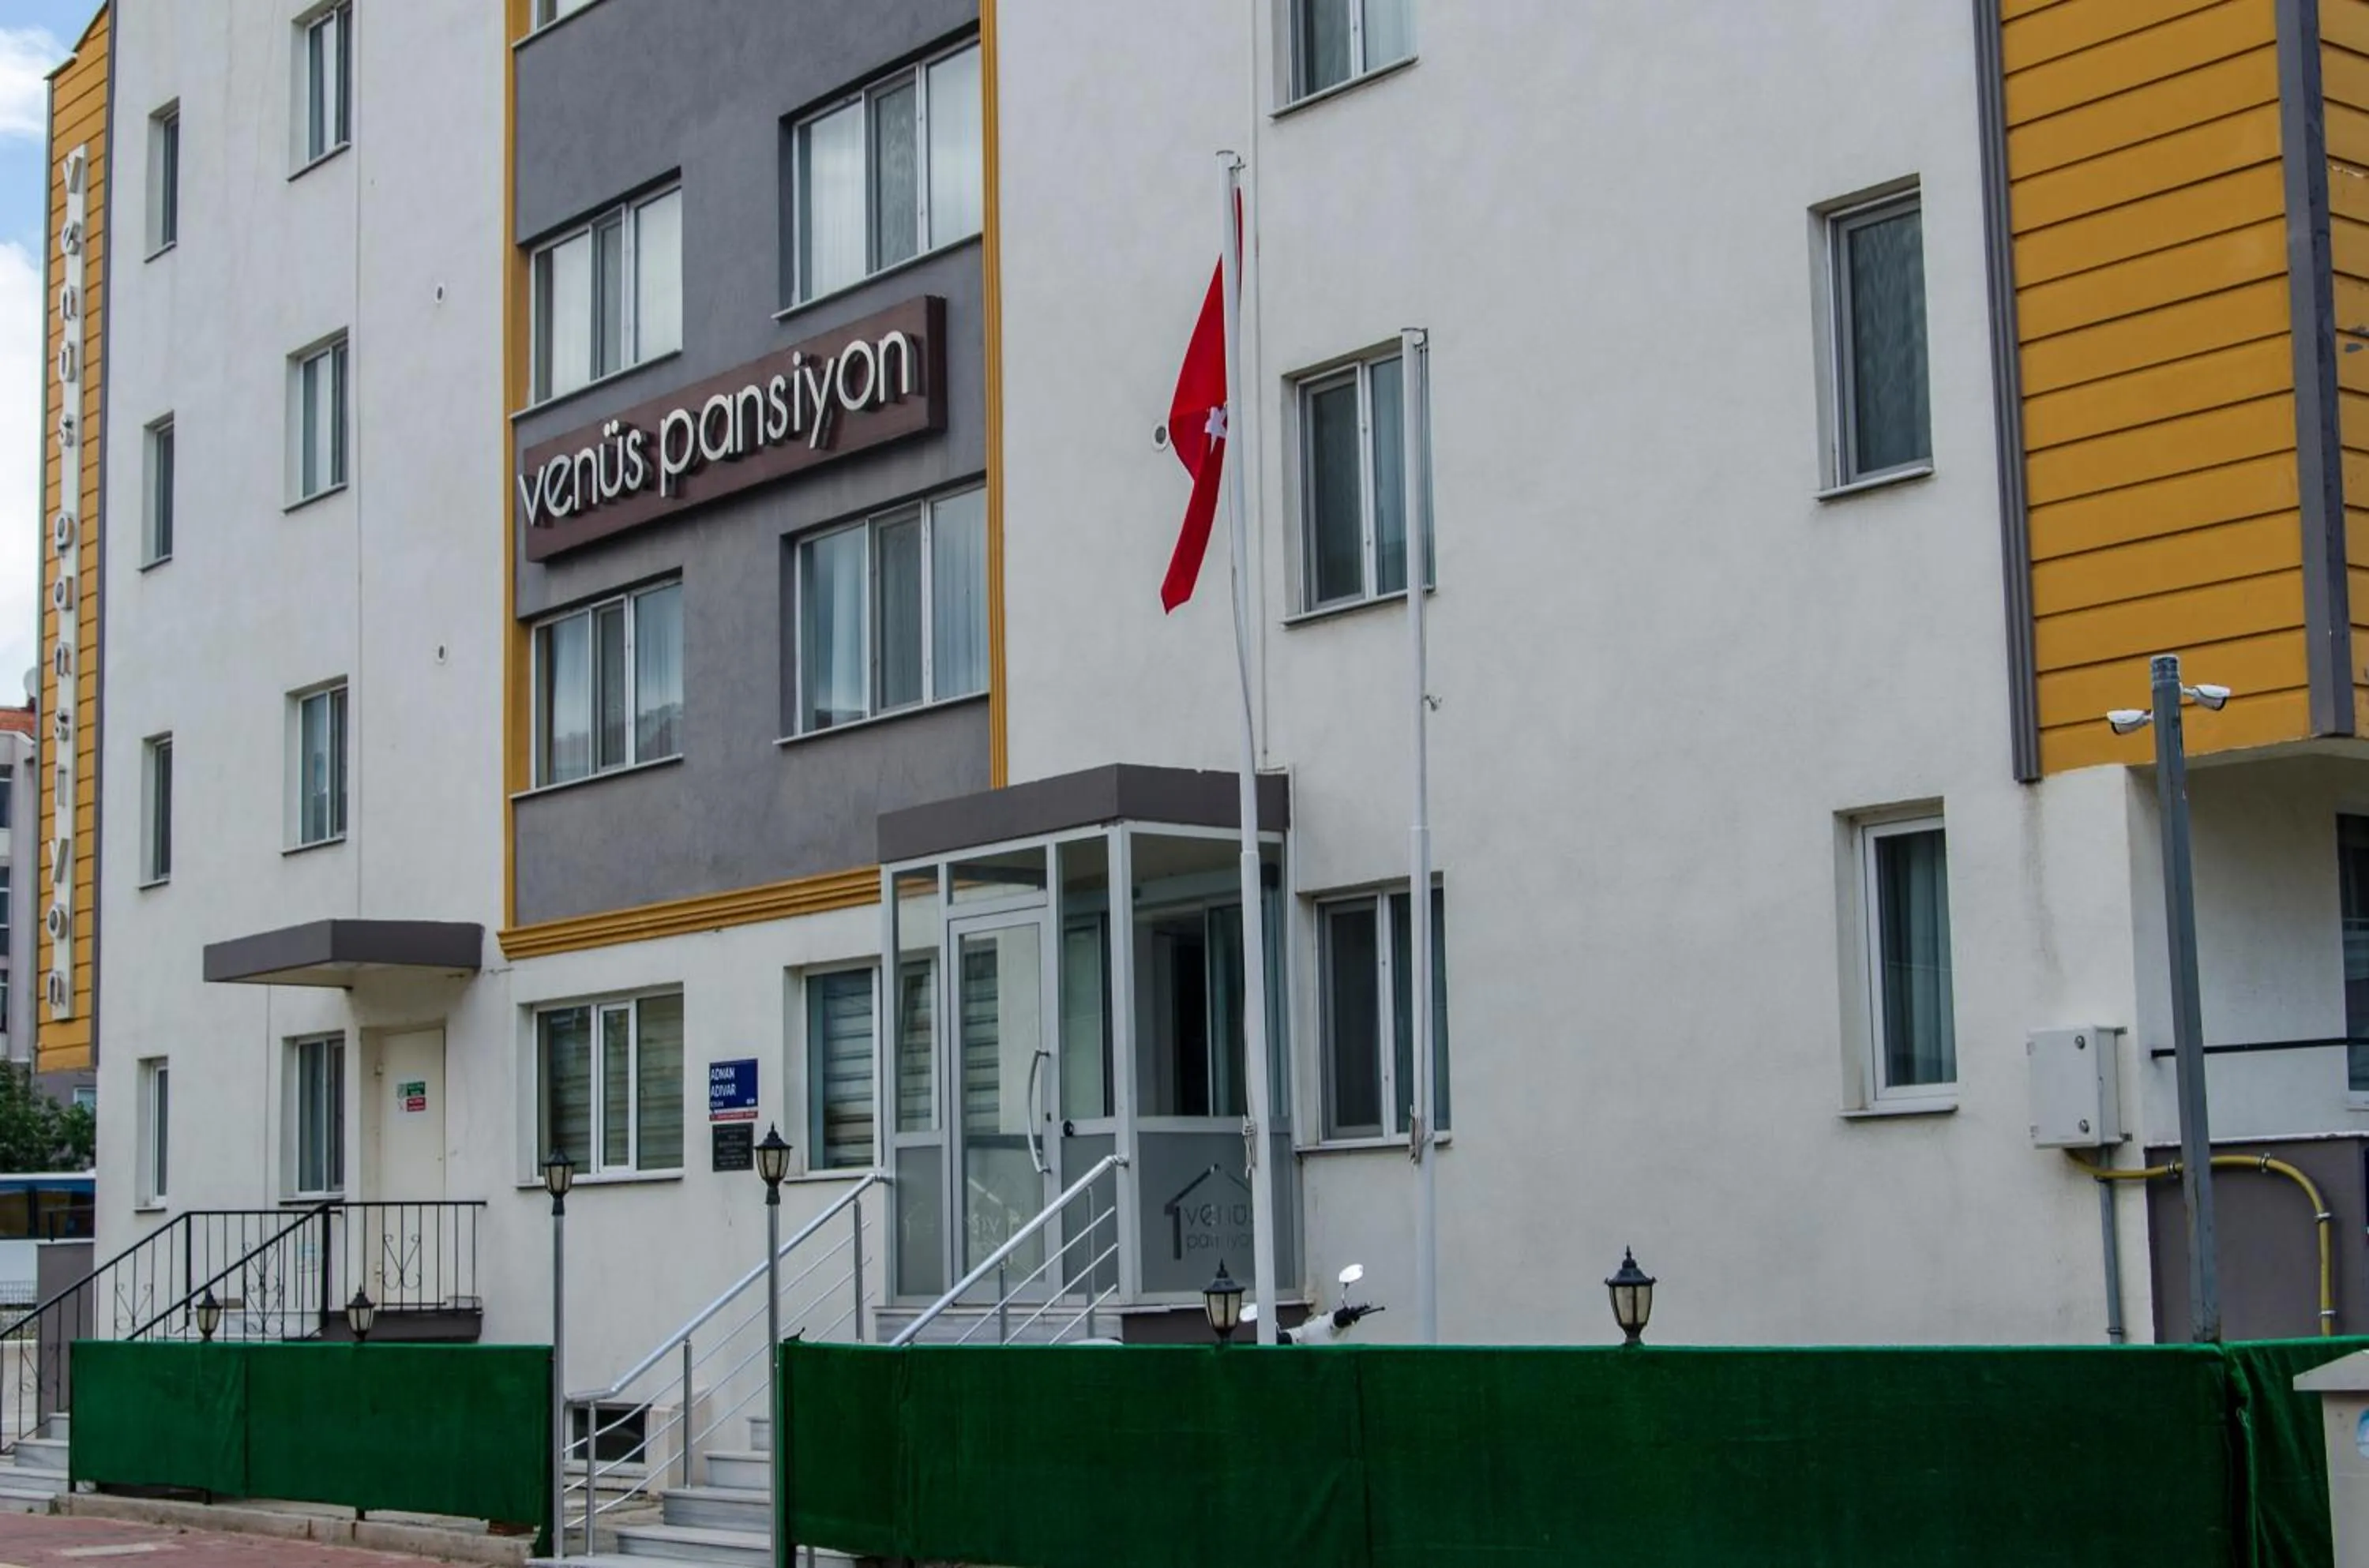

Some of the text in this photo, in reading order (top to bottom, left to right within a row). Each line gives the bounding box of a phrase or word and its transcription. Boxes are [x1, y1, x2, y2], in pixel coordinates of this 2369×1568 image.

[519, 331, 911, 526] venüs pansiyon
[711, 1067, 735, 1081] ADNAN
[1184, 1203, 1252, 1226] venü
